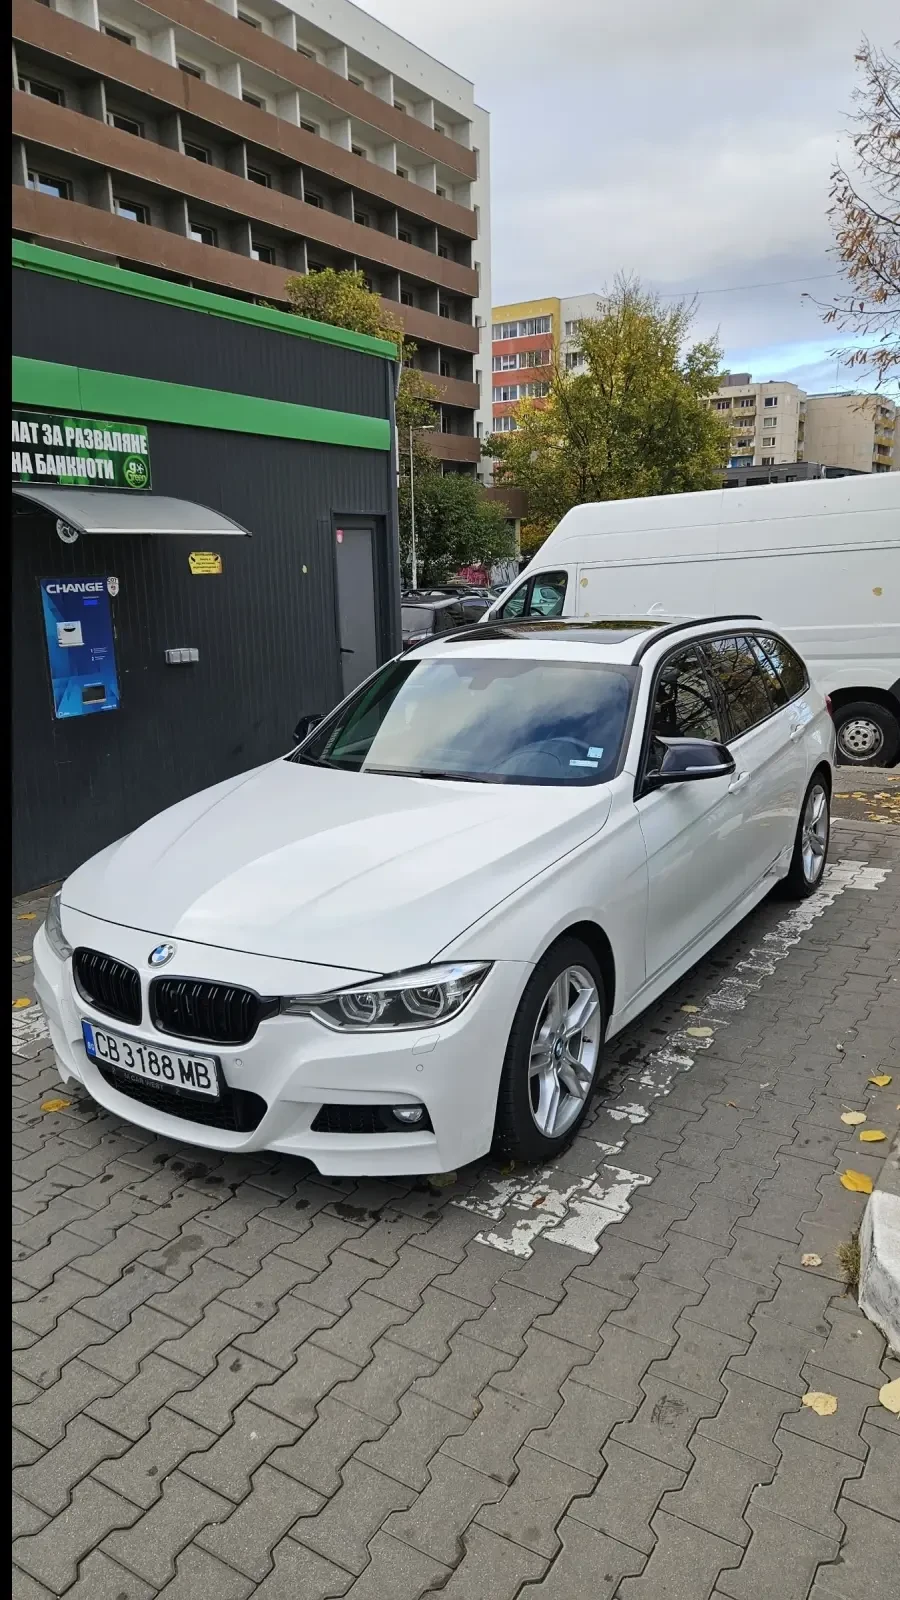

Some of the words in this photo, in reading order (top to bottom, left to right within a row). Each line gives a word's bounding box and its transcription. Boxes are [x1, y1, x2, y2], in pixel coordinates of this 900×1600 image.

[41, 423, 64, 447] ЗА
[65, 426, 148, 455] РАЗВАЛЯНЕ
[12, 451, 34, 474] НА
[35, 453, 114, 480] БАНКНОТИ
[46, 582, 104, 594] CHANGE
[95, 1031, 120, 1062] CB
[123, 1042, 175, 1080] 3188
[177, 1058, 211, 1089] MB
